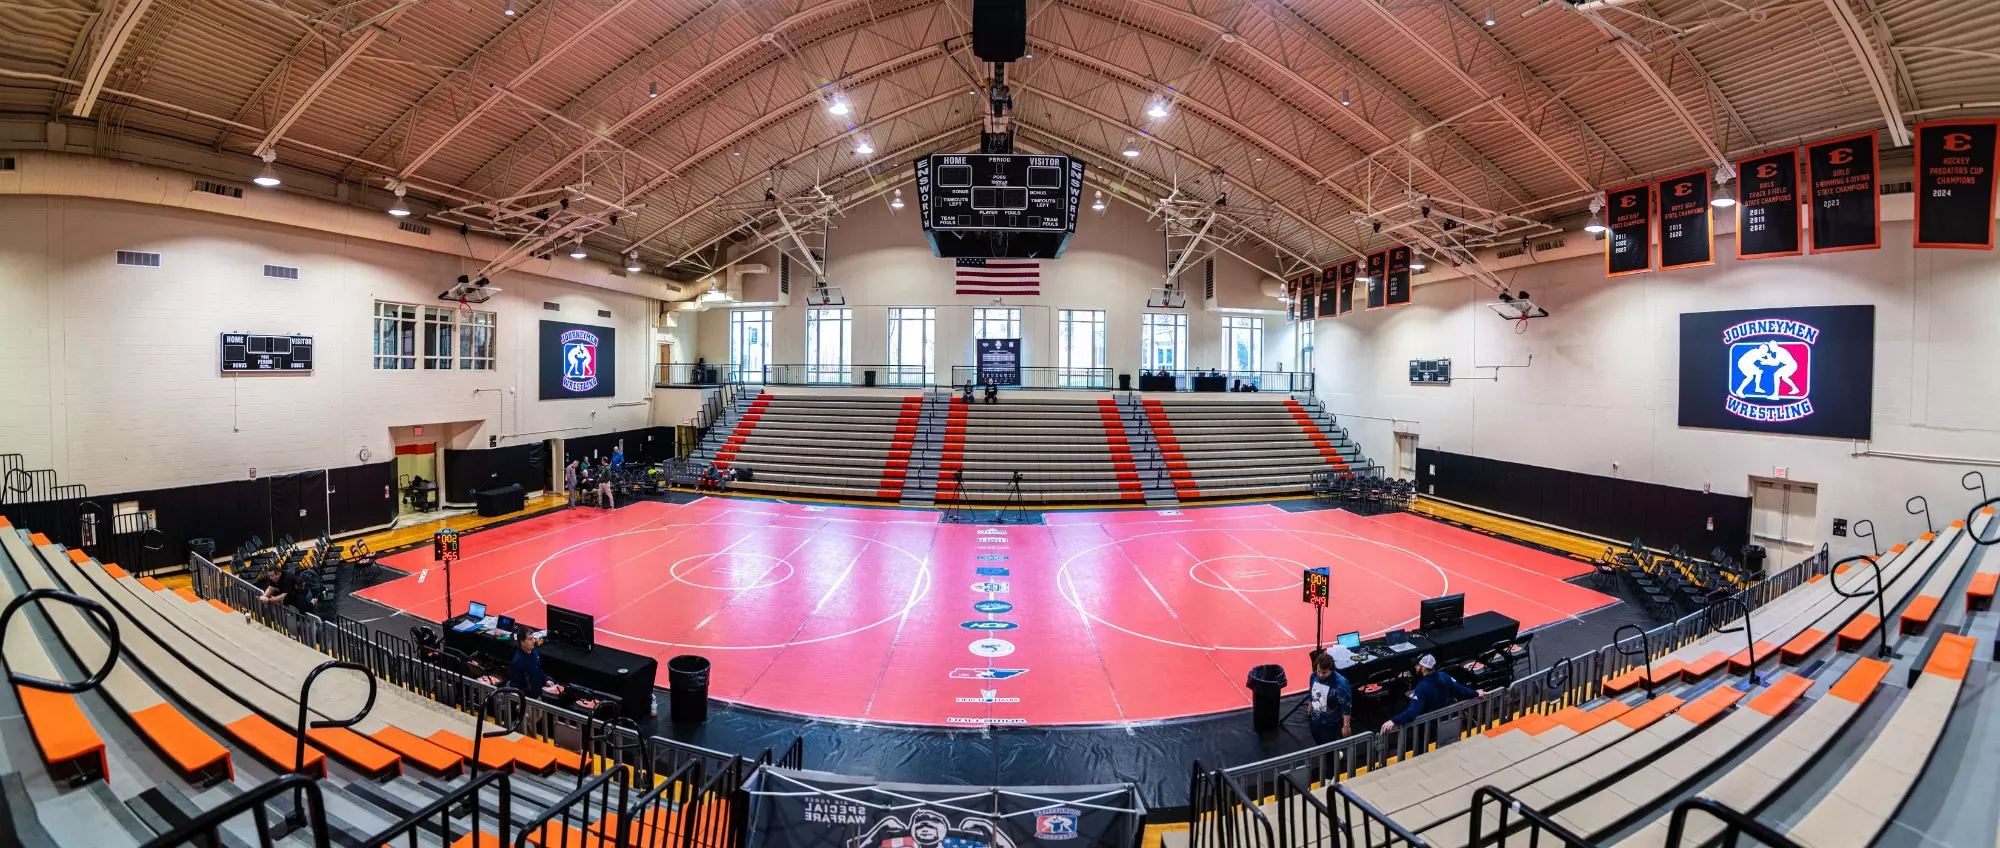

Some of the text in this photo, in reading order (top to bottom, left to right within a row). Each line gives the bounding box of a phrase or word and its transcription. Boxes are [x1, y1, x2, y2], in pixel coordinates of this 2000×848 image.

[1030, 158, 1059, 166] VISITOR
[1930, 166, 1968, 175] PREDATORS
[917, 159, 929, 227] ENSWORTH
[1069, 162, 1082, 230] ENSWORTH
[1749, 190, 1766, 198] TRACK
[1817, 183, 1869, 196] STATE CHAMPIONS
[1744, 194, 1792, 207] STATE CHAMPIONS
[561, 330, 599, 347] JOURNEYMEN
[1723, 319, 1820, 344] JOURNEYMEN
[1726, 395, 1814, 421] WRESTLING
